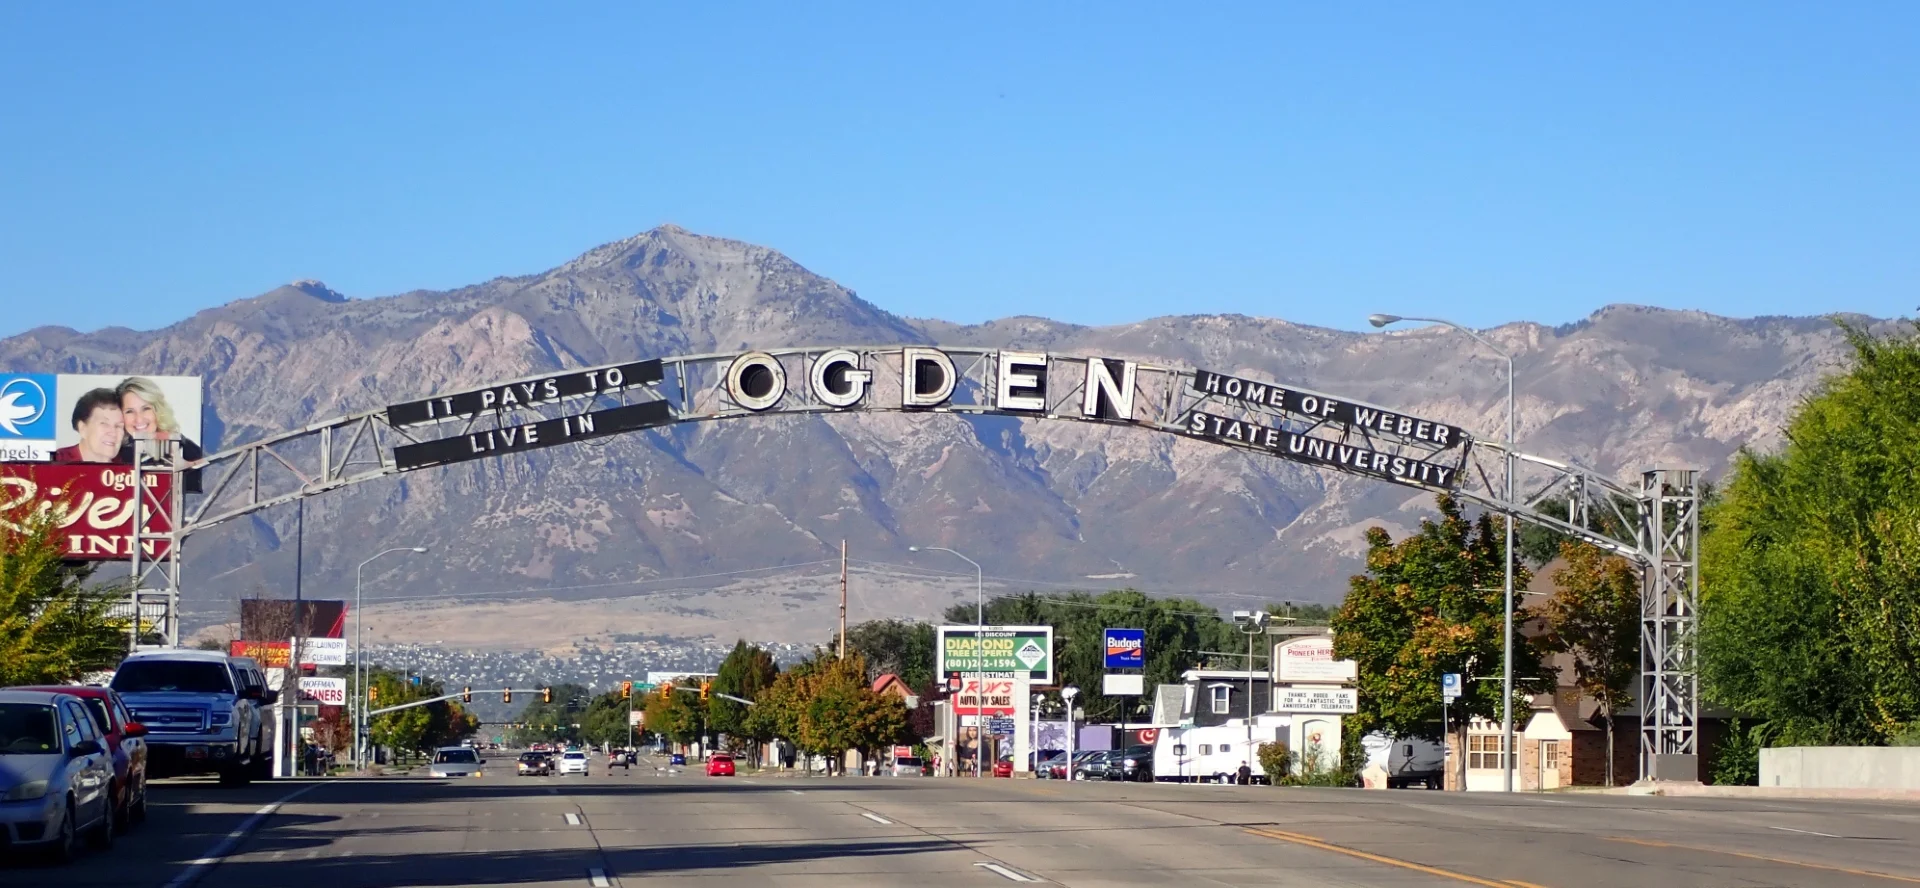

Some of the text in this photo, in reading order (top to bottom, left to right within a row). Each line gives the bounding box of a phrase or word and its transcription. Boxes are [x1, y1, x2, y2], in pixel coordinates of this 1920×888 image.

[726, 346, 1138, 421] OGDEN
[426, 368, 625, 418] IT PAYS TO
[1205, 373, 1451, 445] HOME OF WEBER
[470, 413, 595, 453] LIVE IN
[0, 445, 39, 461] ngels
[1190, 412, 1452, 485] STATE UNIVERSITY
[68, 534, 155, 555] INN
[317, 641, 344, 649] LAUNDRY
[946, 639, 1014, 649] DIAMOND
[1107, 637, 1142, 650] Budget
[303, 680, 336, 688] HOFFMAN
[991, 696, 1010, 706] SALES
